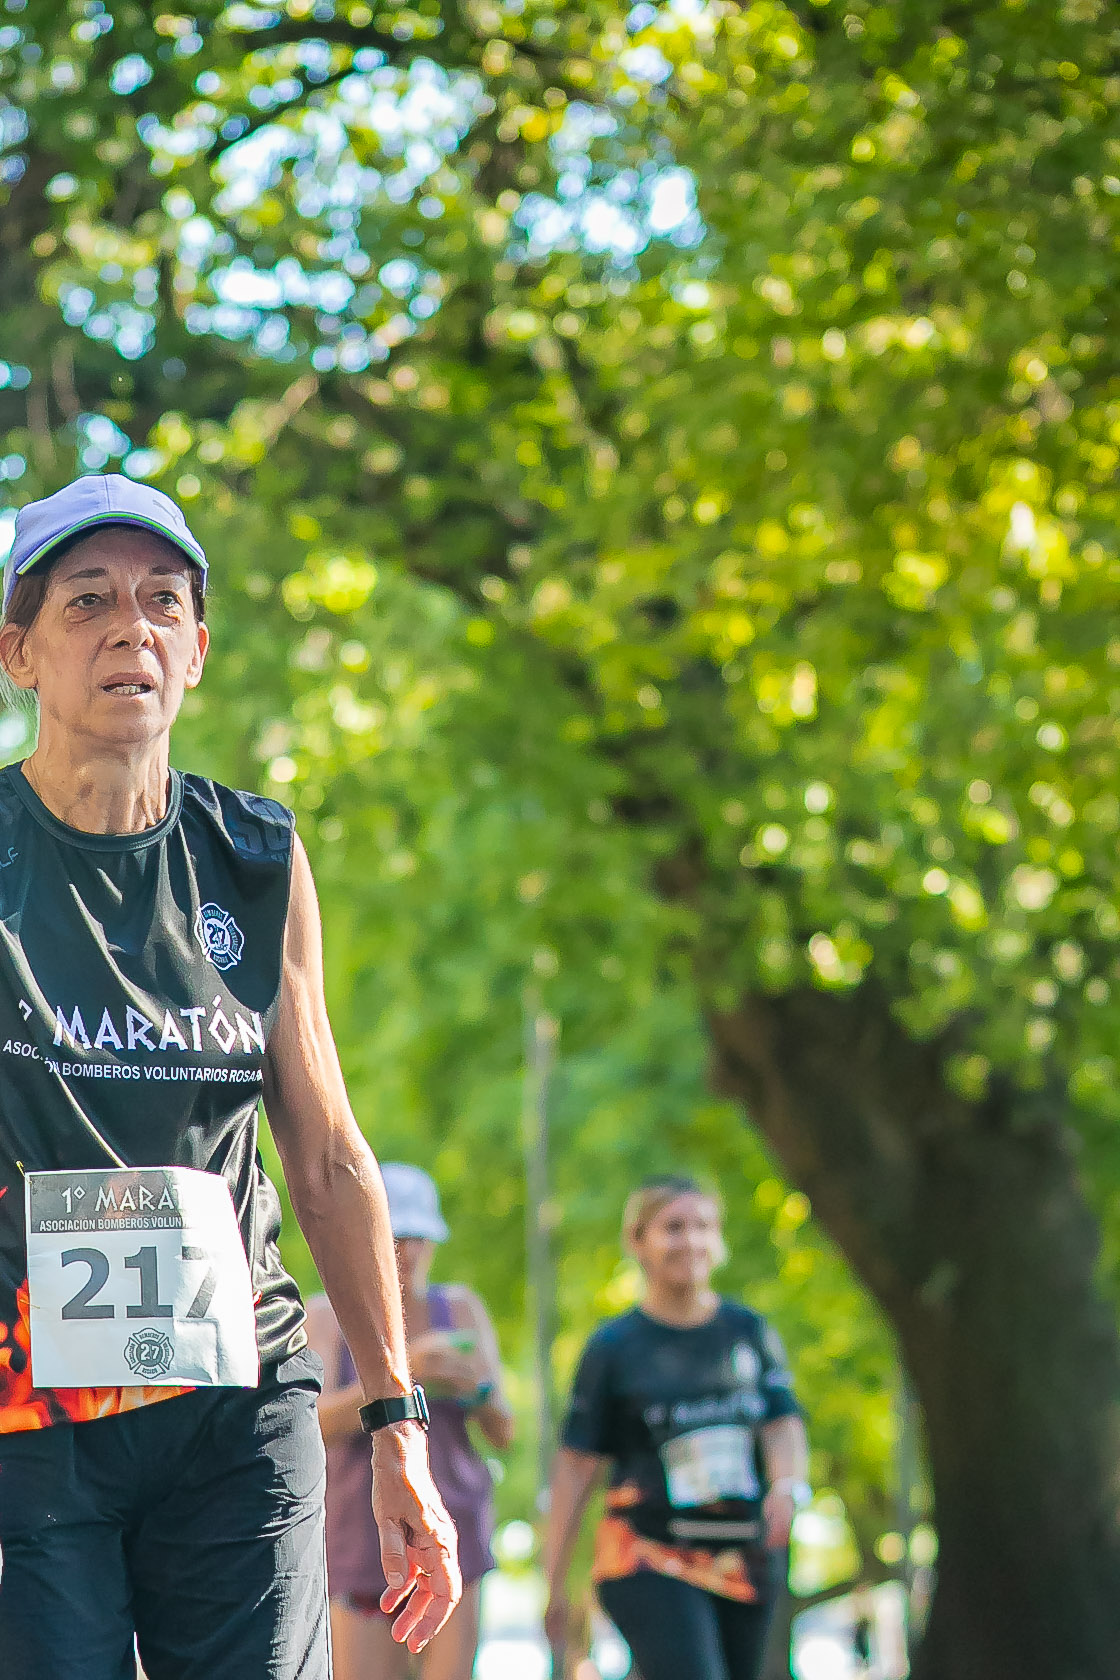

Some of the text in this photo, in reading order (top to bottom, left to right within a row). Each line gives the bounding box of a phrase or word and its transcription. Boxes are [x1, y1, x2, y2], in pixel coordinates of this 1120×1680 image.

[53, 994, 266, 1055] MARATÓN
[62, 1062, 141, 1080] BOMBEROS
[144, 1066, 228, 1082] VOLUNTARIOS
[39, 1216, 95, 1232] ASOCIACIÓN
[97, 1217, 149, 1230] BOMBEROS
[60, 1246, 217, 1320] 217
[140, 1343, 161, 1361] 27
